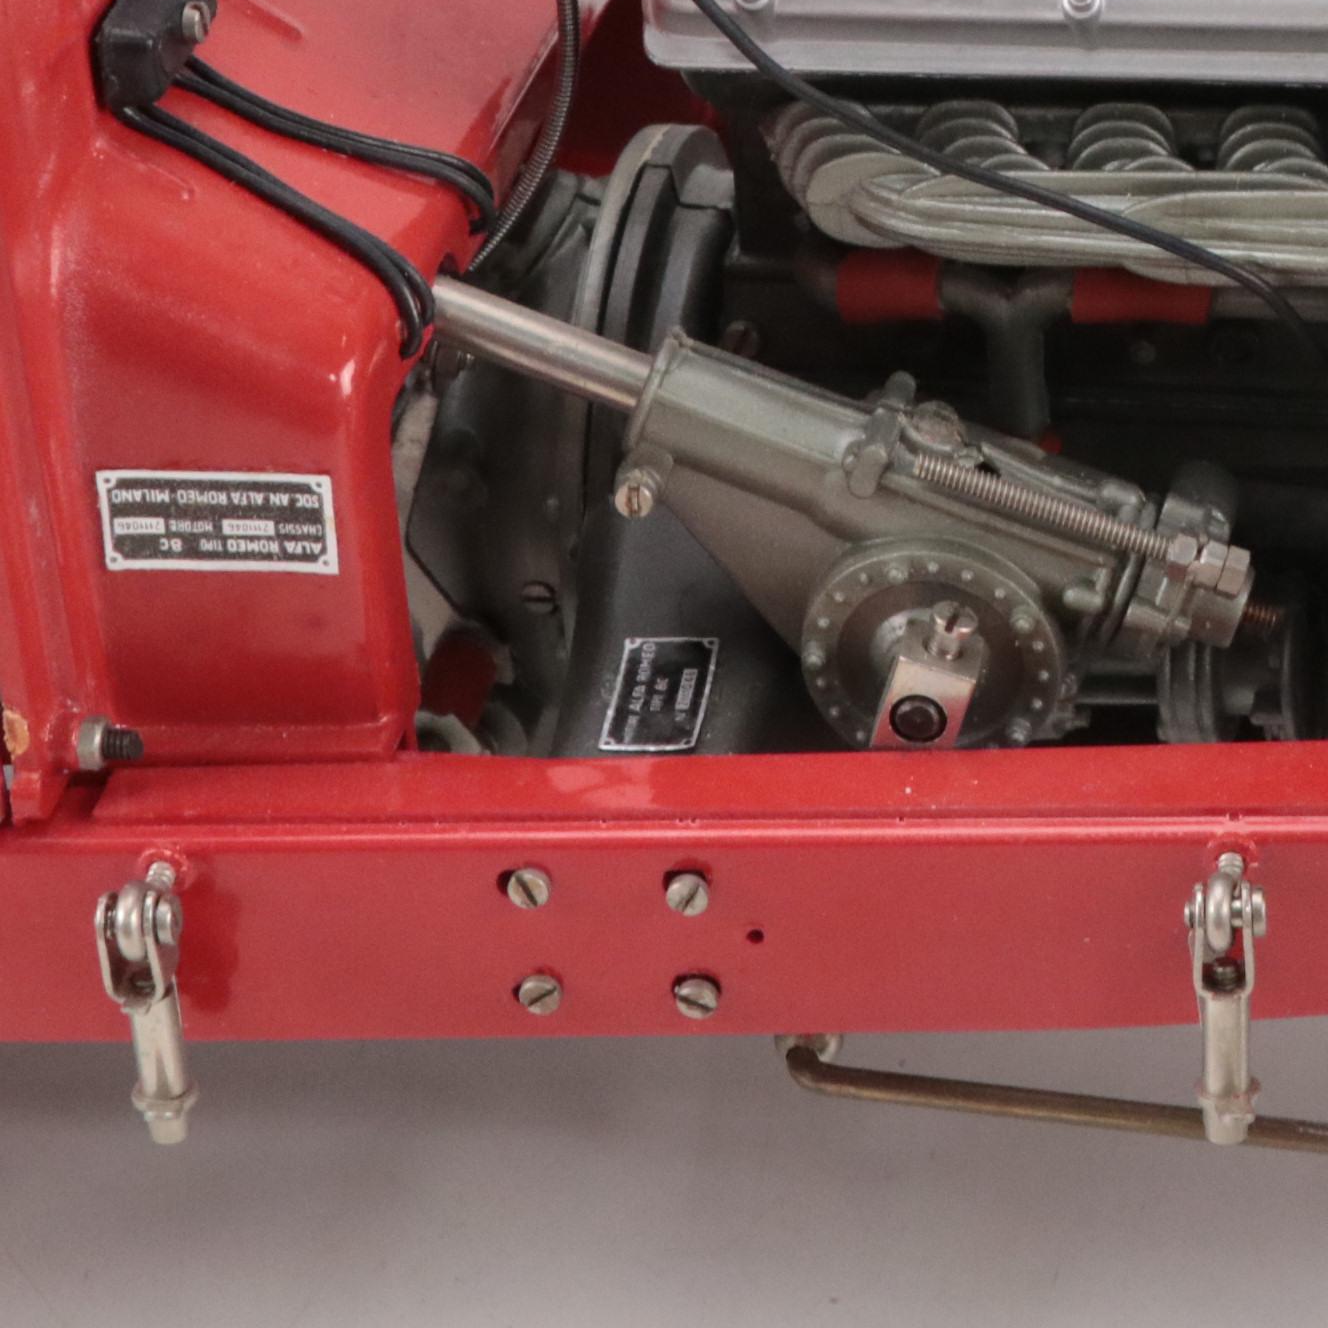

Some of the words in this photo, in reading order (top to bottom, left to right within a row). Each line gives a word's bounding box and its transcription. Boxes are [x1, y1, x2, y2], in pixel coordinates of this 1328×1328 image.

[230, 491, 264, 504] ALFA
[199, 538, 223, 551] TIPO
[226, 538, 278, 553] ROMEO
[284, 539, 322, 554] ALFA
